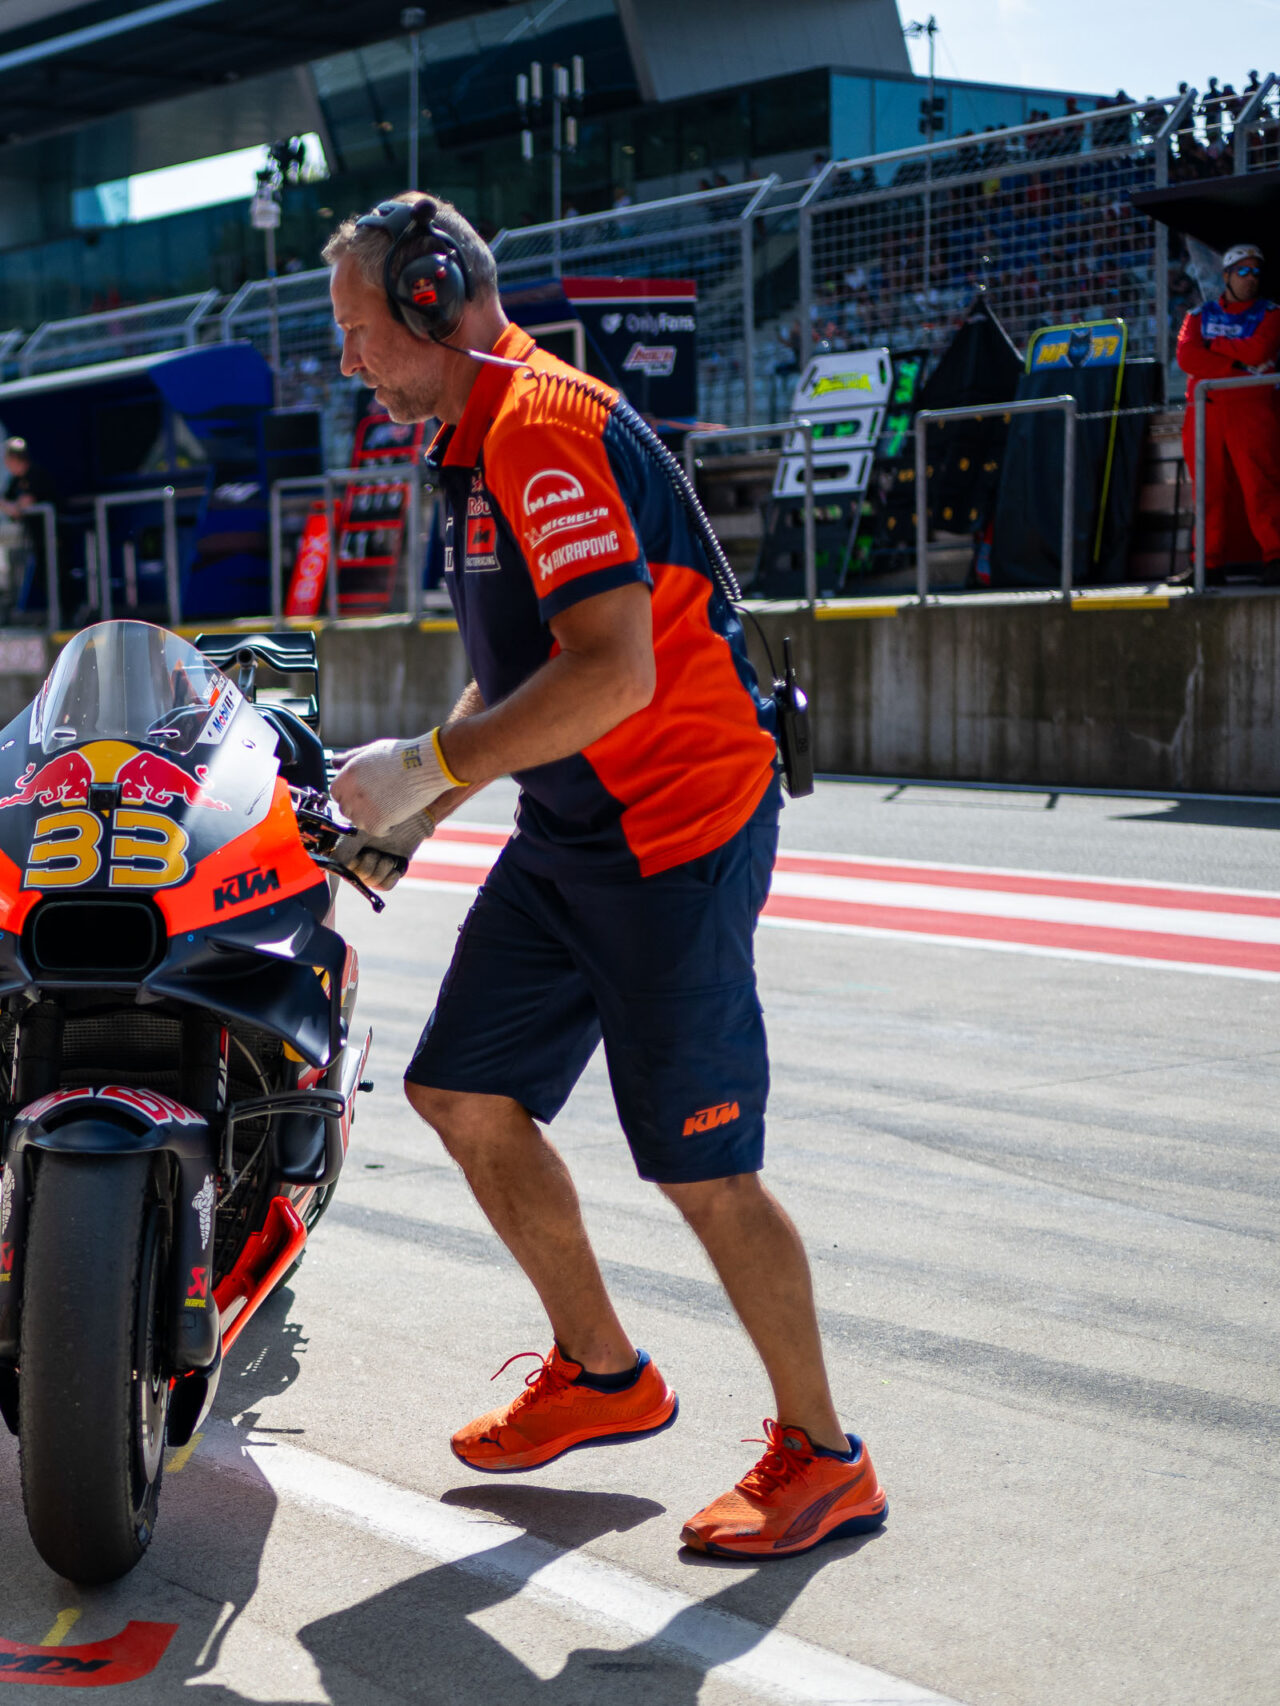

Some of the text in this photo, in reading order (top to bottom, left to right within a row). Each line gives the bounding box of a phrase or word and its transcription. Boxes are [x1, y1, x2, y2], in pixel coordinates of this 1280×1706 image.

[528, 487, 580, 514] MAN
[540, 507, 609, 534] MICHELIN
[22, 810, 189, 889] 33
[213, 866, 280, 912] KTM
[682, 1101, 740, 1137] KTM
